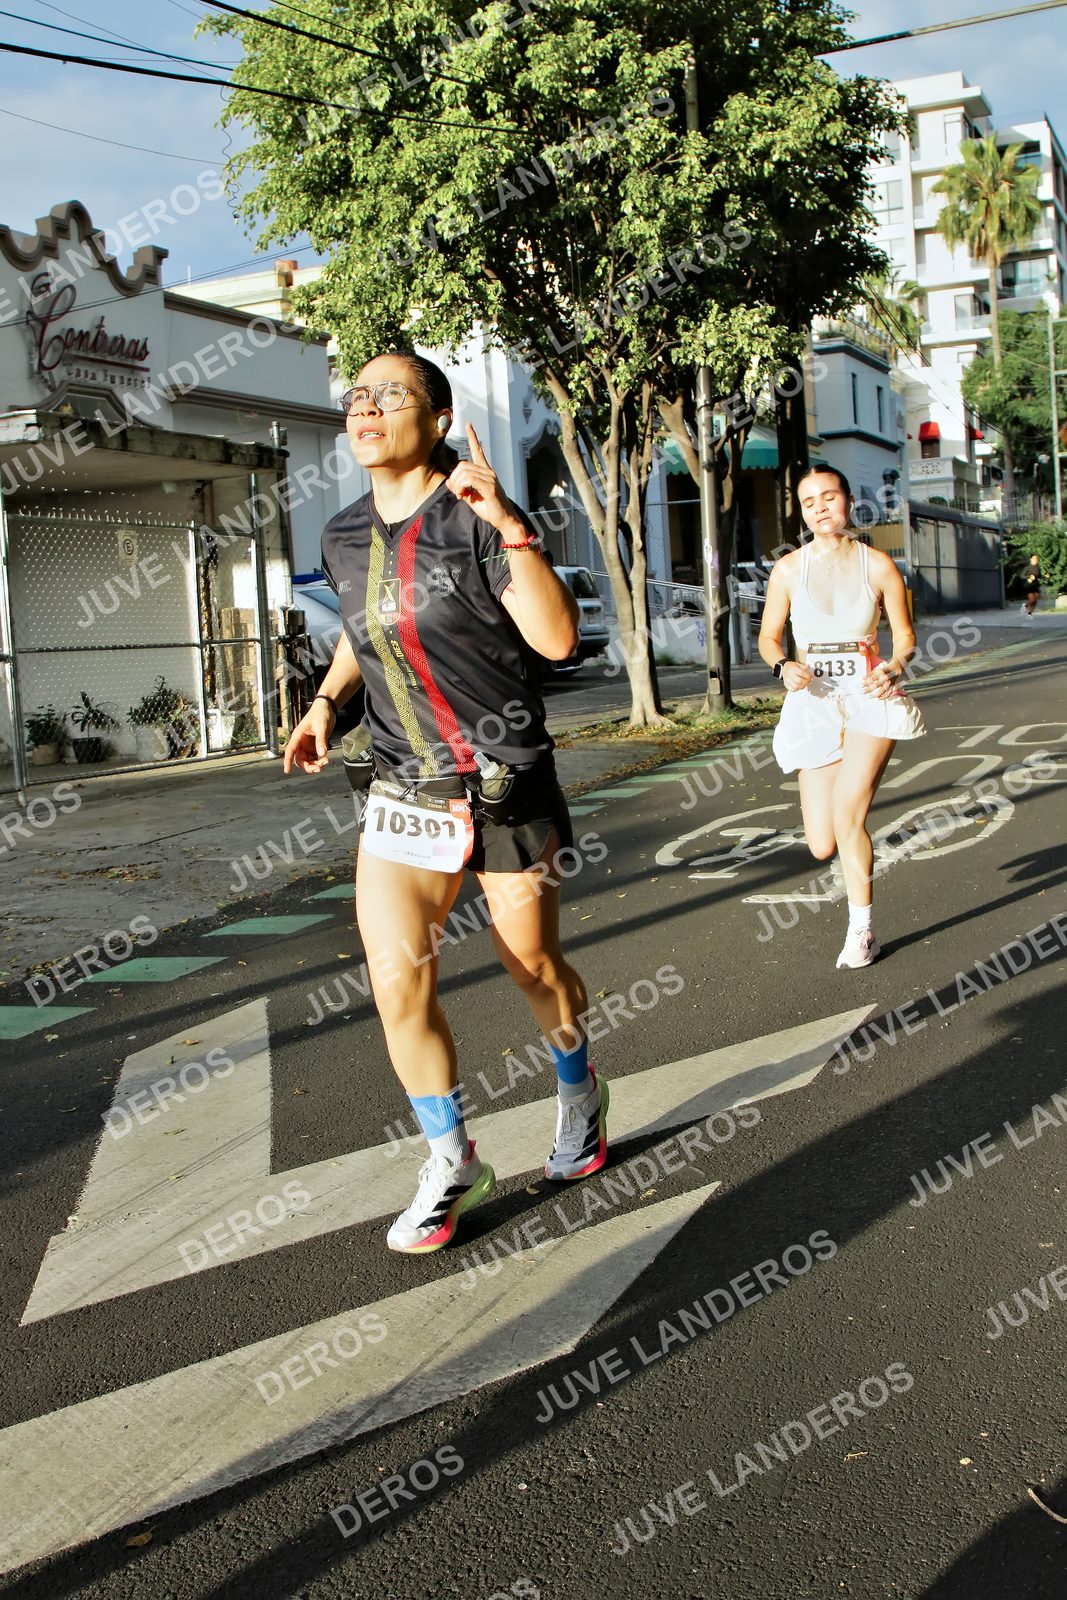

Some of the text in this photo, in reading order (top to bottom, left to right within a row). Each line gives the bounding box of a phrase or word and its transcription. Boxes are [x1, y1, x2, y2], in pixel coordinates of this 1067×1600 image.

[26, 278, 150, 371] Contreras
[813, 659, 857, 678] 8133
[373, 806, 456, 840] 10301
